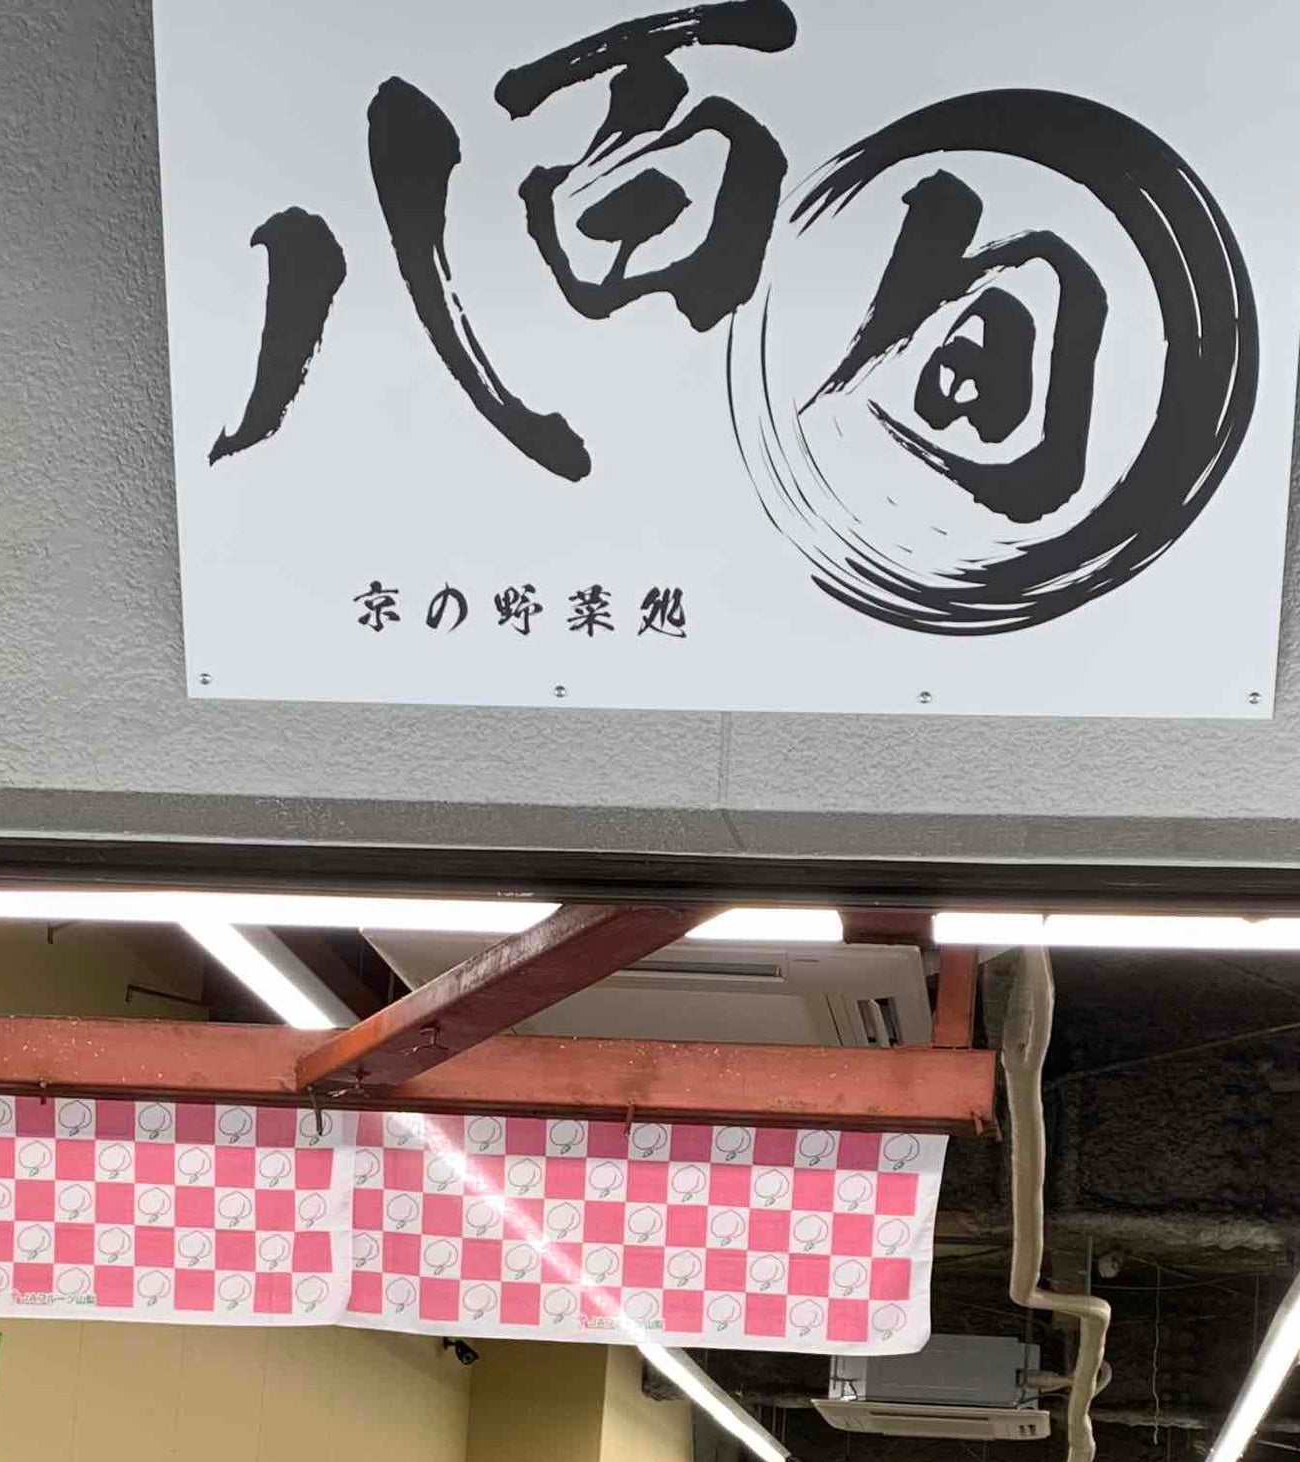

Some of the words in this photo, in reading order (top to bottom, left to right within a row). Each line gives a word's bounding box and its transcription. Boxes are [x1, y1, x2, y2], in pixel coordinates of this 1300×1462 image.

[208, 0, 1140, 523] 八百旬
[353, 579, 688, 640] 京の野菜処
